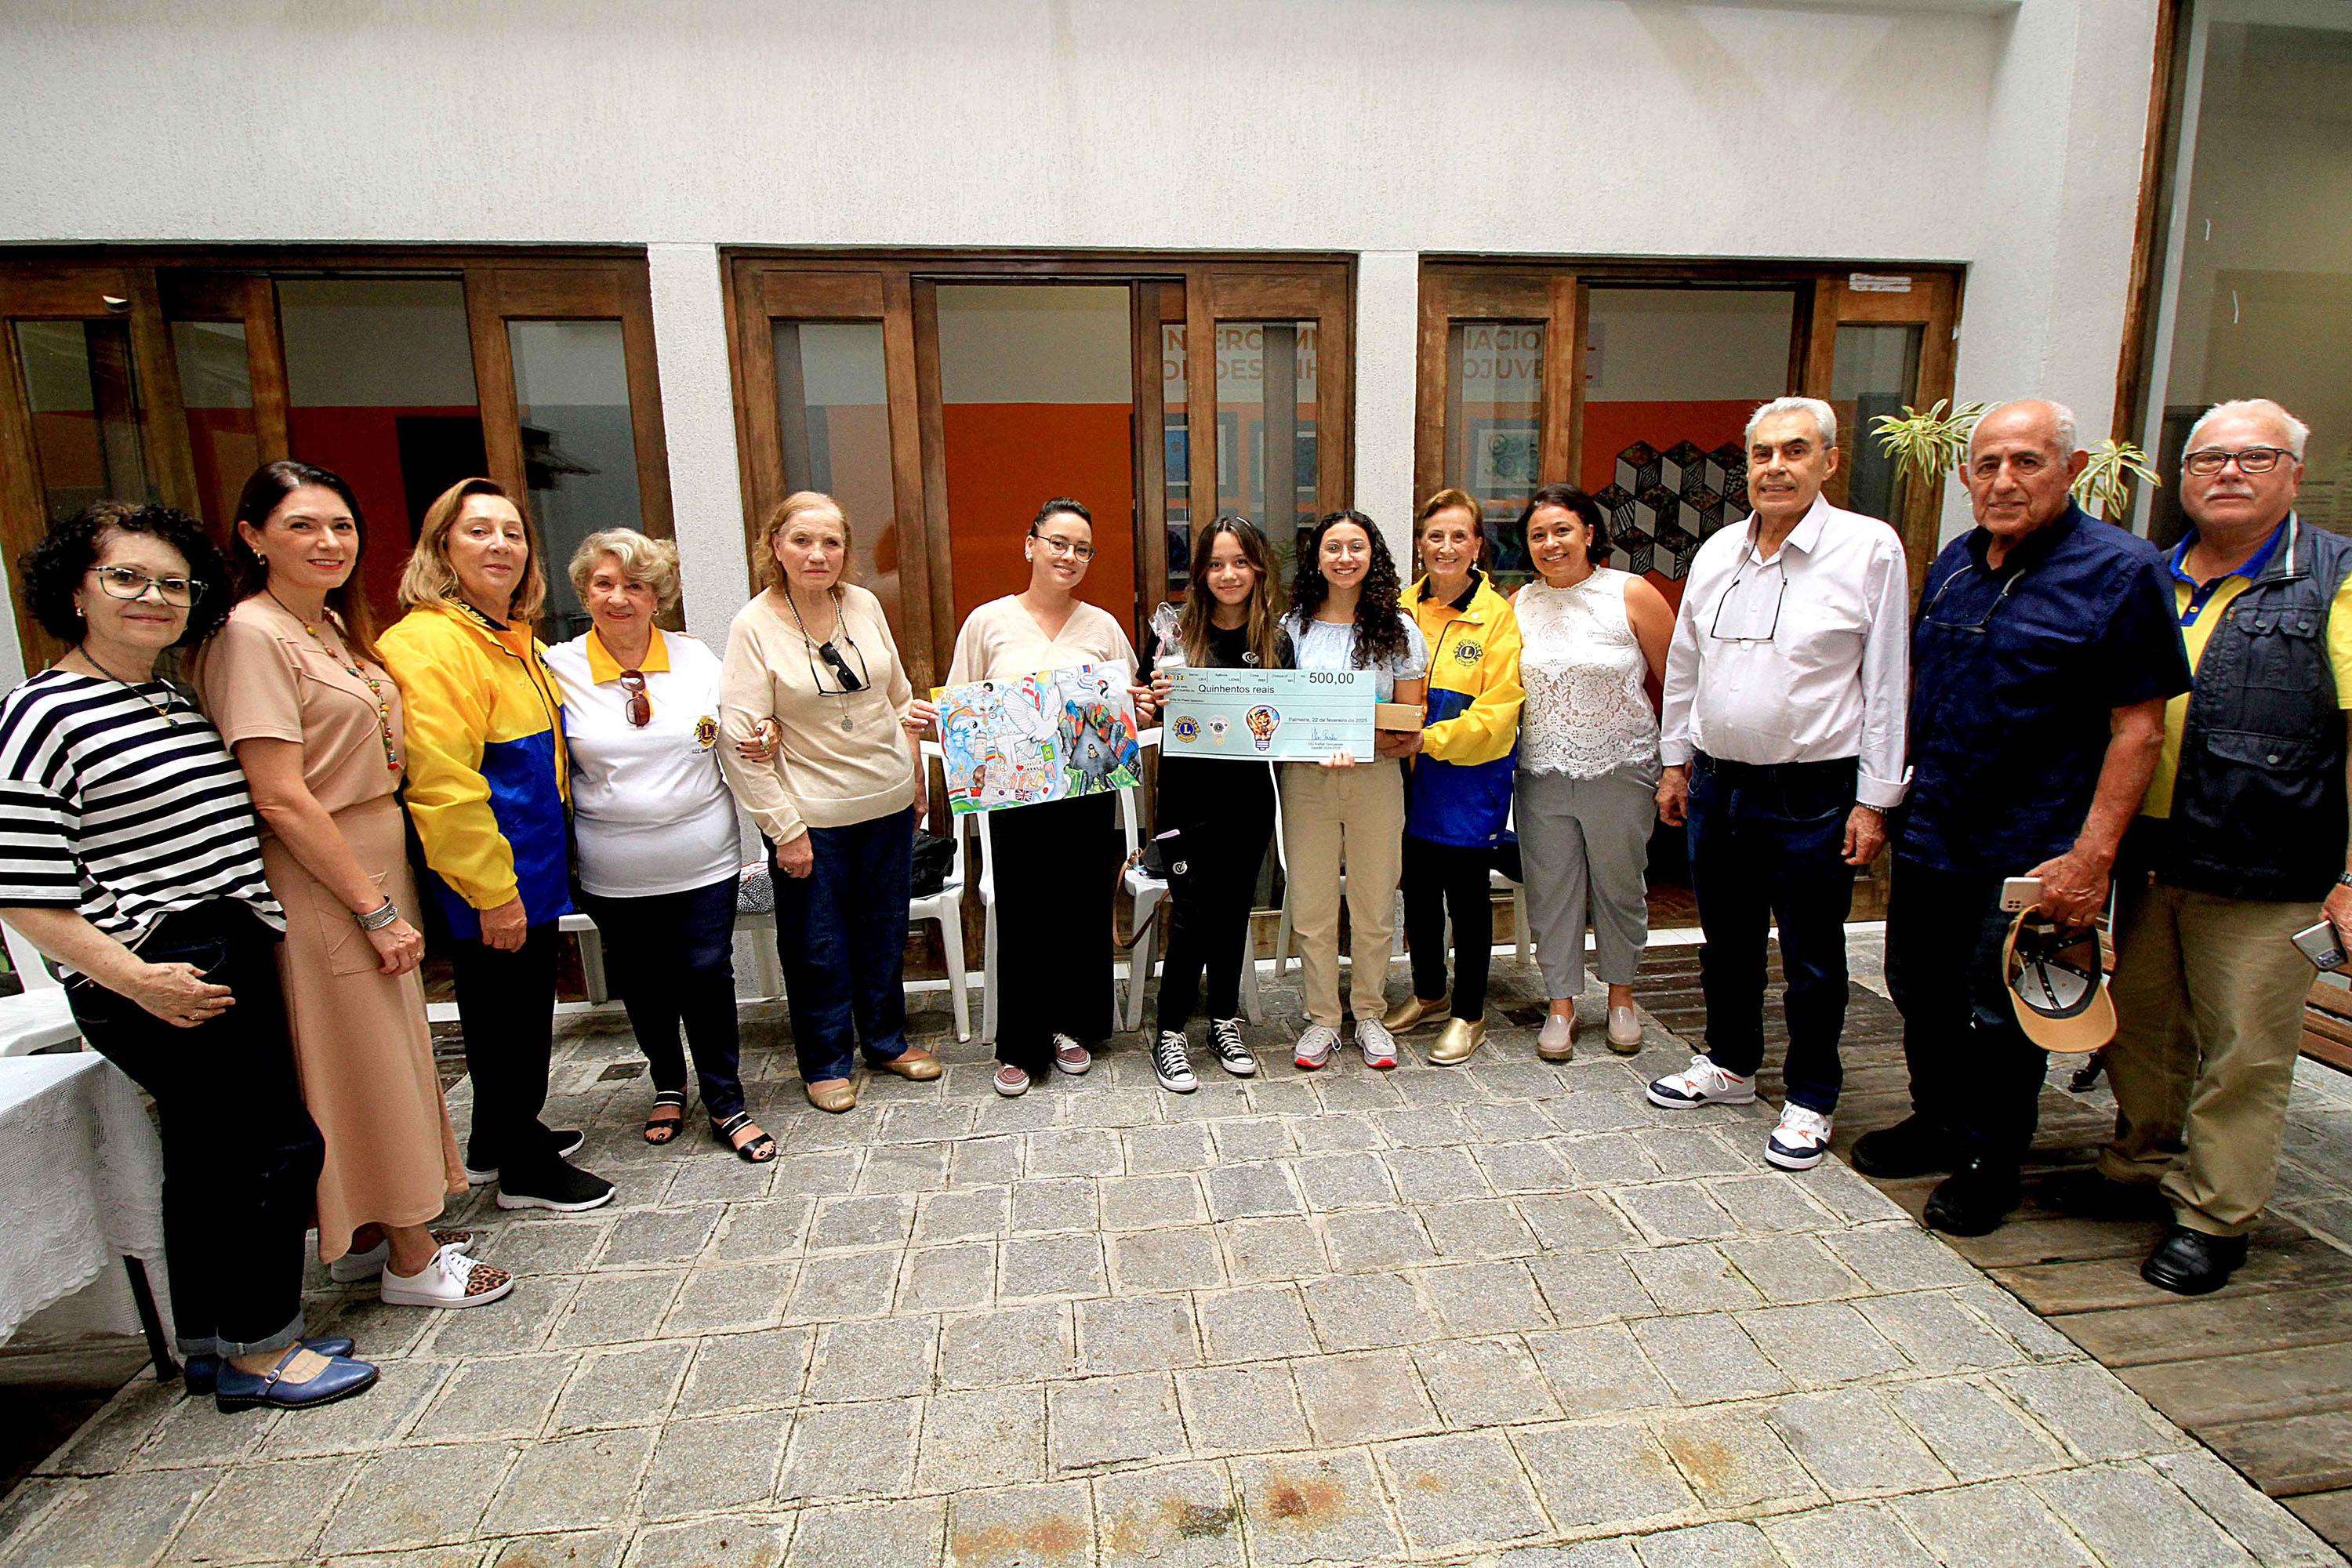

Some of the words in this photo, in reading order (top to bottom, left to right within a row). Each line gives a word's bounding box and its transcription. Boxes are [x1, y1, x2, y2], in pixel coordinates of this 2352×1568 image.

[1309, 672, 1354, 685] 500,00
[1198, 684, 1250, 693] Quinhentos
[1184, 724, 1191, 734] L
